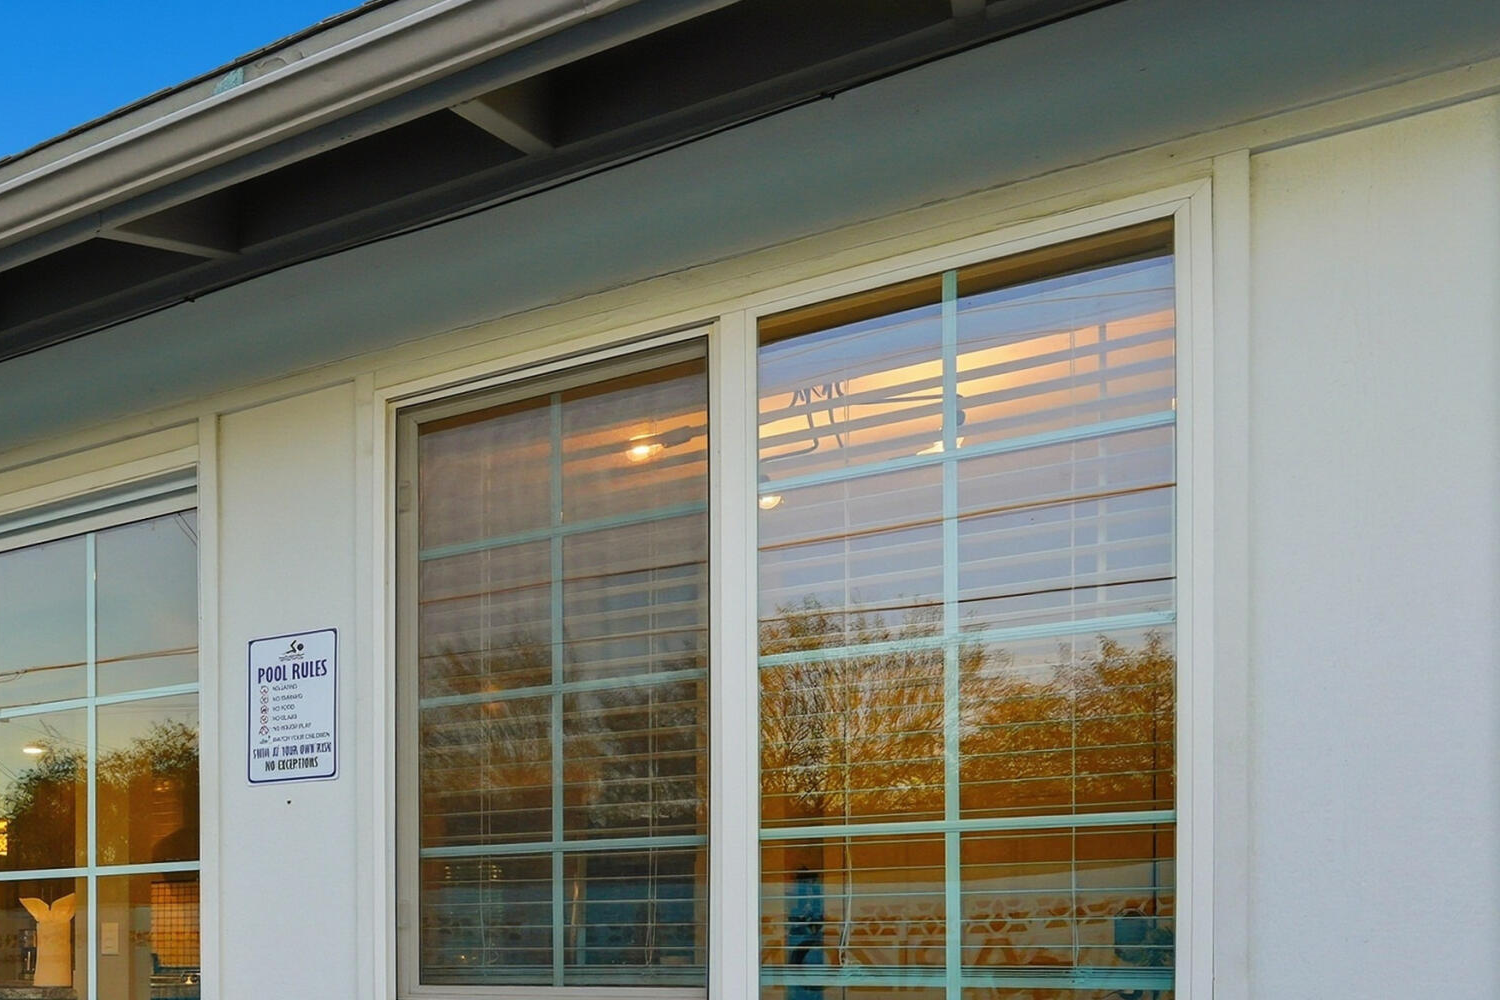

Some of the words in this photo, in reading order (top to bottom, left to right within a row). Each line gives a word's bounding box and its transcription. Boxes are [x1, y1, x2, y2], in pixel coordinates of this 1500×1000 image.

[258, 665, 287, 684] POOL
[292, 659, 327, 680] RULES
[282, 745, 298, 756] YOUR
[265, 760, 275, 771] NO
[278, 756, 318, 770] EXCEPTIONS
